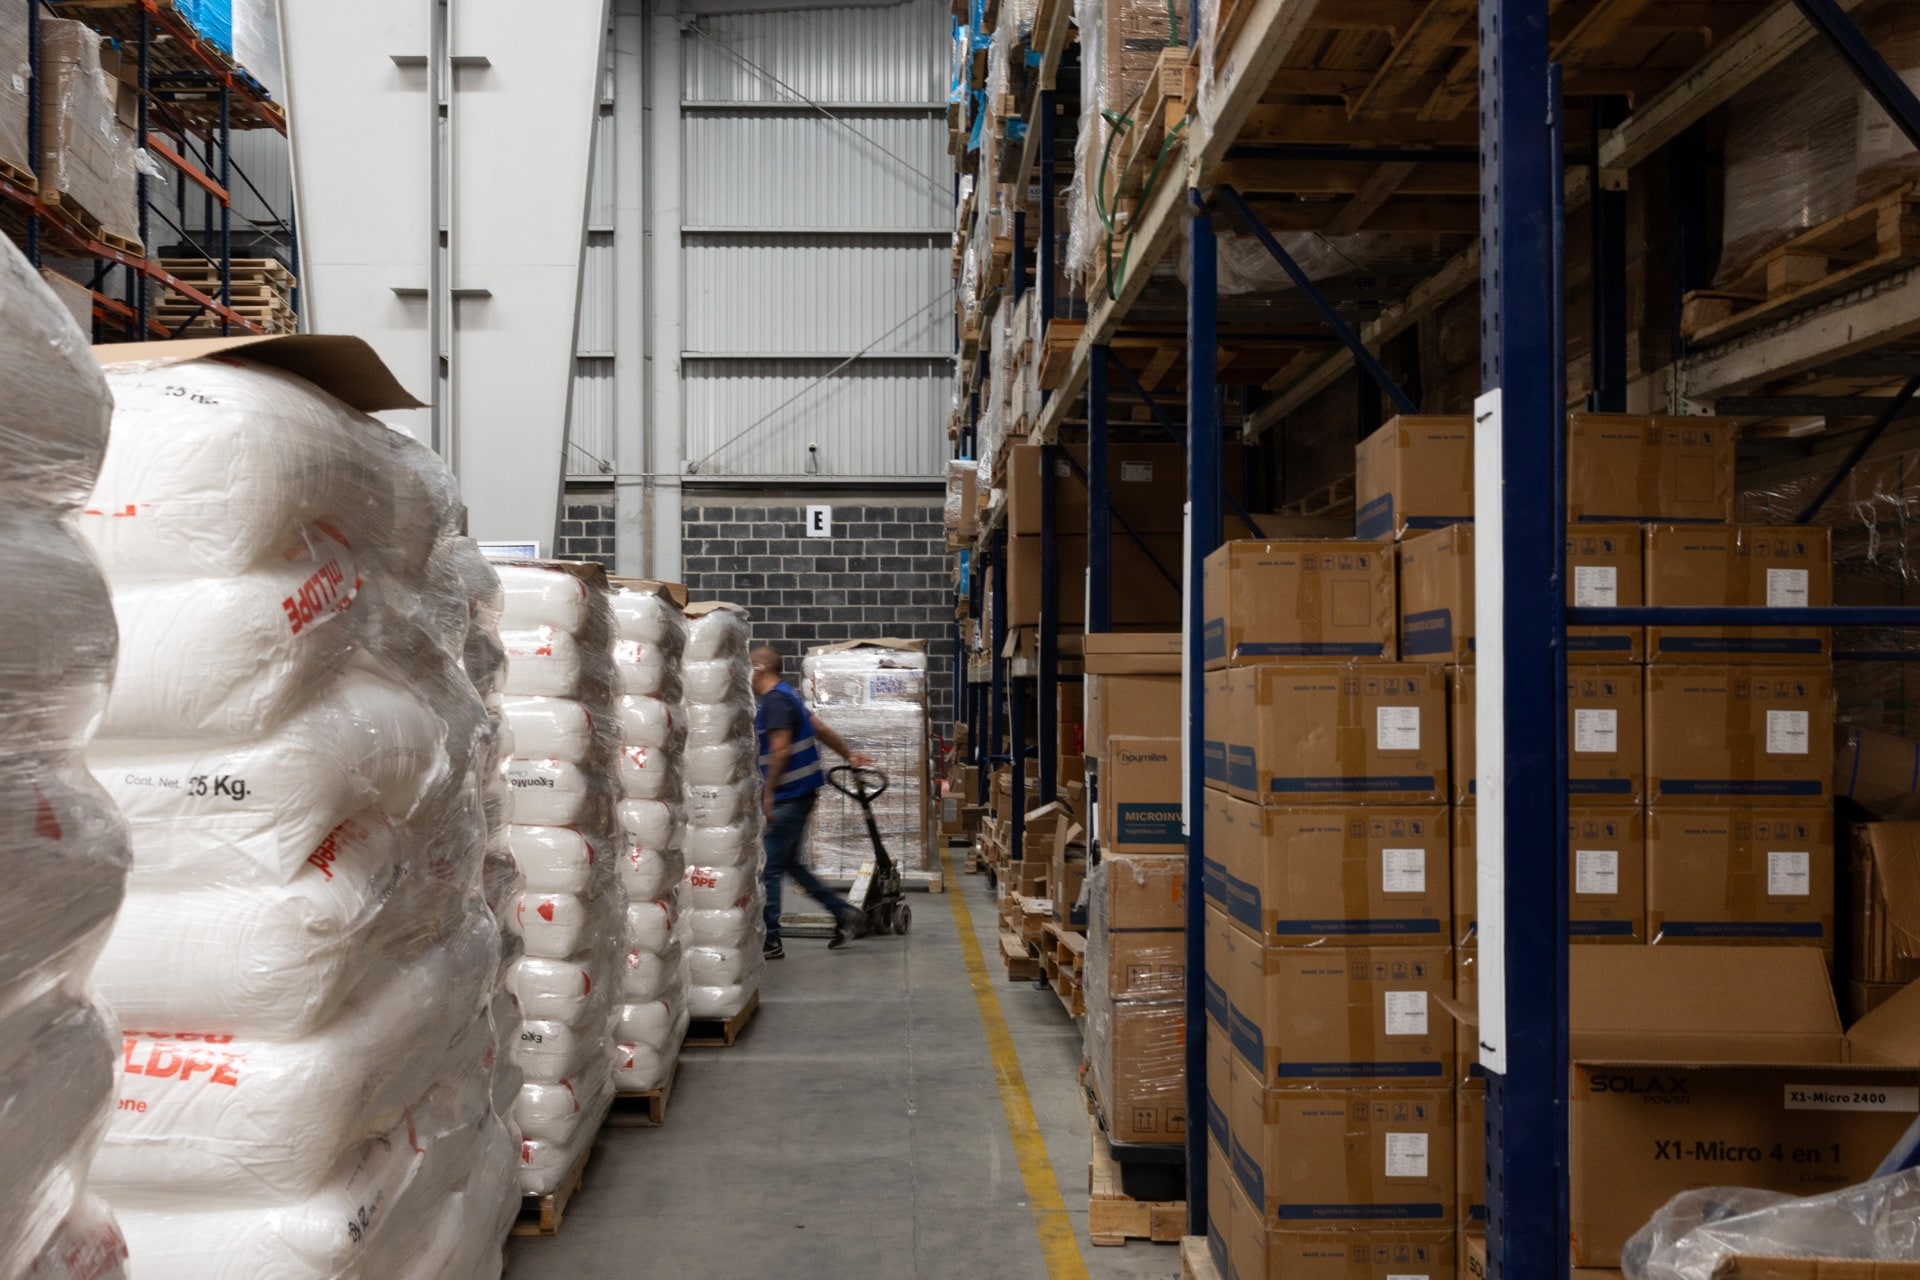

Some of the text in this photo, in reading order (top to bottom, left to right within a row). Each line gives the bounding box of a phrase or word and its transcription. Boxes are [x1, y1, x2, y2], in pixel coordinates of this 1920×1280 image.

[814, 511, 824, 530] E
[1122, 752, 1167, 764] hoymiles
[125, 774, 154, 787] Cont.
[213, 774, 251, 801] Kg.
[1589, 1074, 1689, 1094] SOLAX
[1643, 1095, 1690, 1105] POWER
[1790, 1091, 1887, 1104] X1-Micro 2400
[1654, 1140, 1841, 1163] X1-Micro 4 en 1
